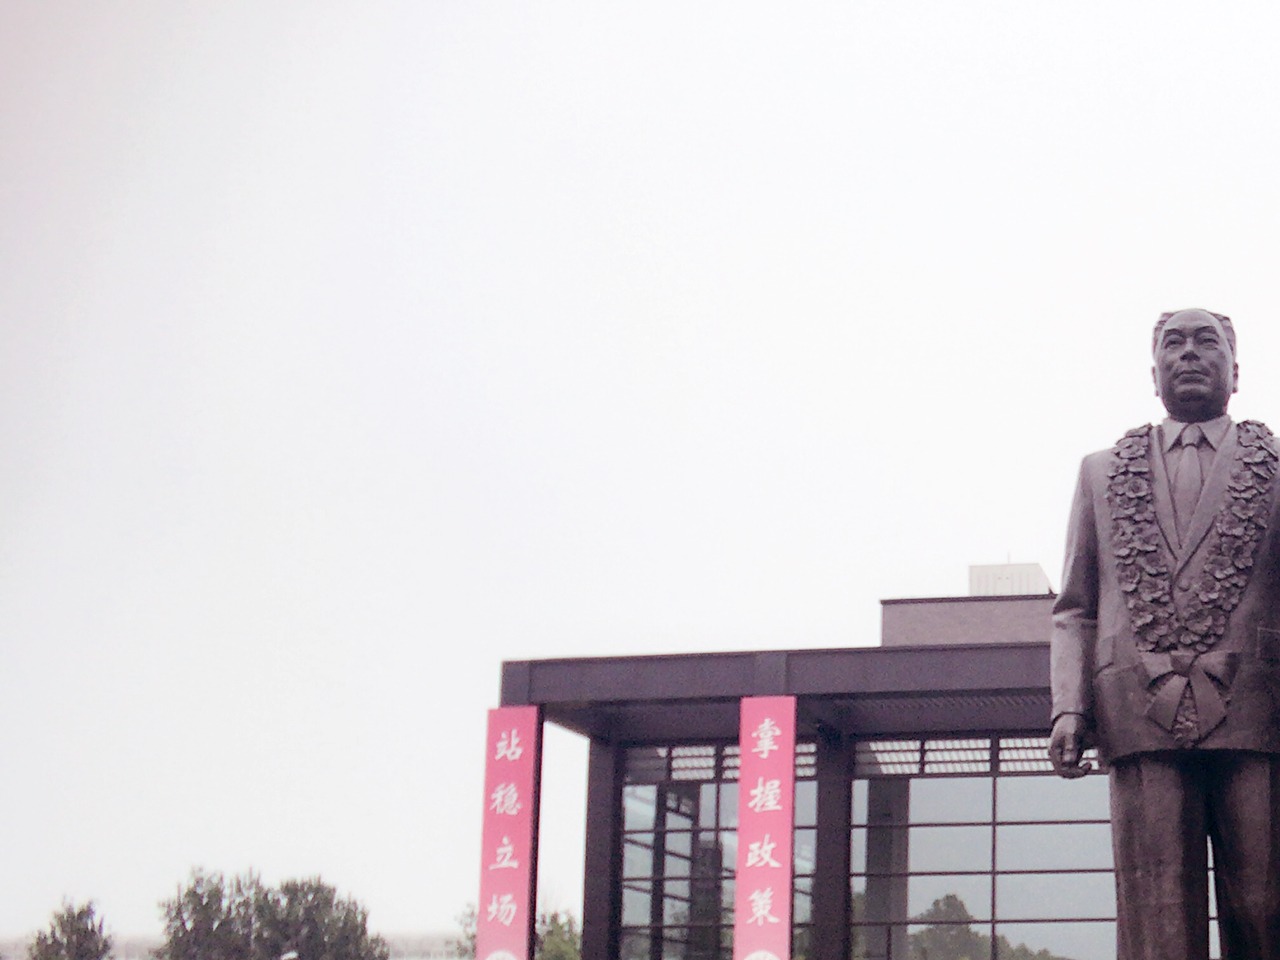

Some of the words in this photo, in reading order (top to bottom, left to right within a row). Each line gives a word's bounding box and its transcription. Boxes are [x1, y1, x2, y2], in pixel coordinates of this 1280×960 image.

[487, 728, 522, 927] 站稳立场
[745, 717, 783, 926] 掌握政策
